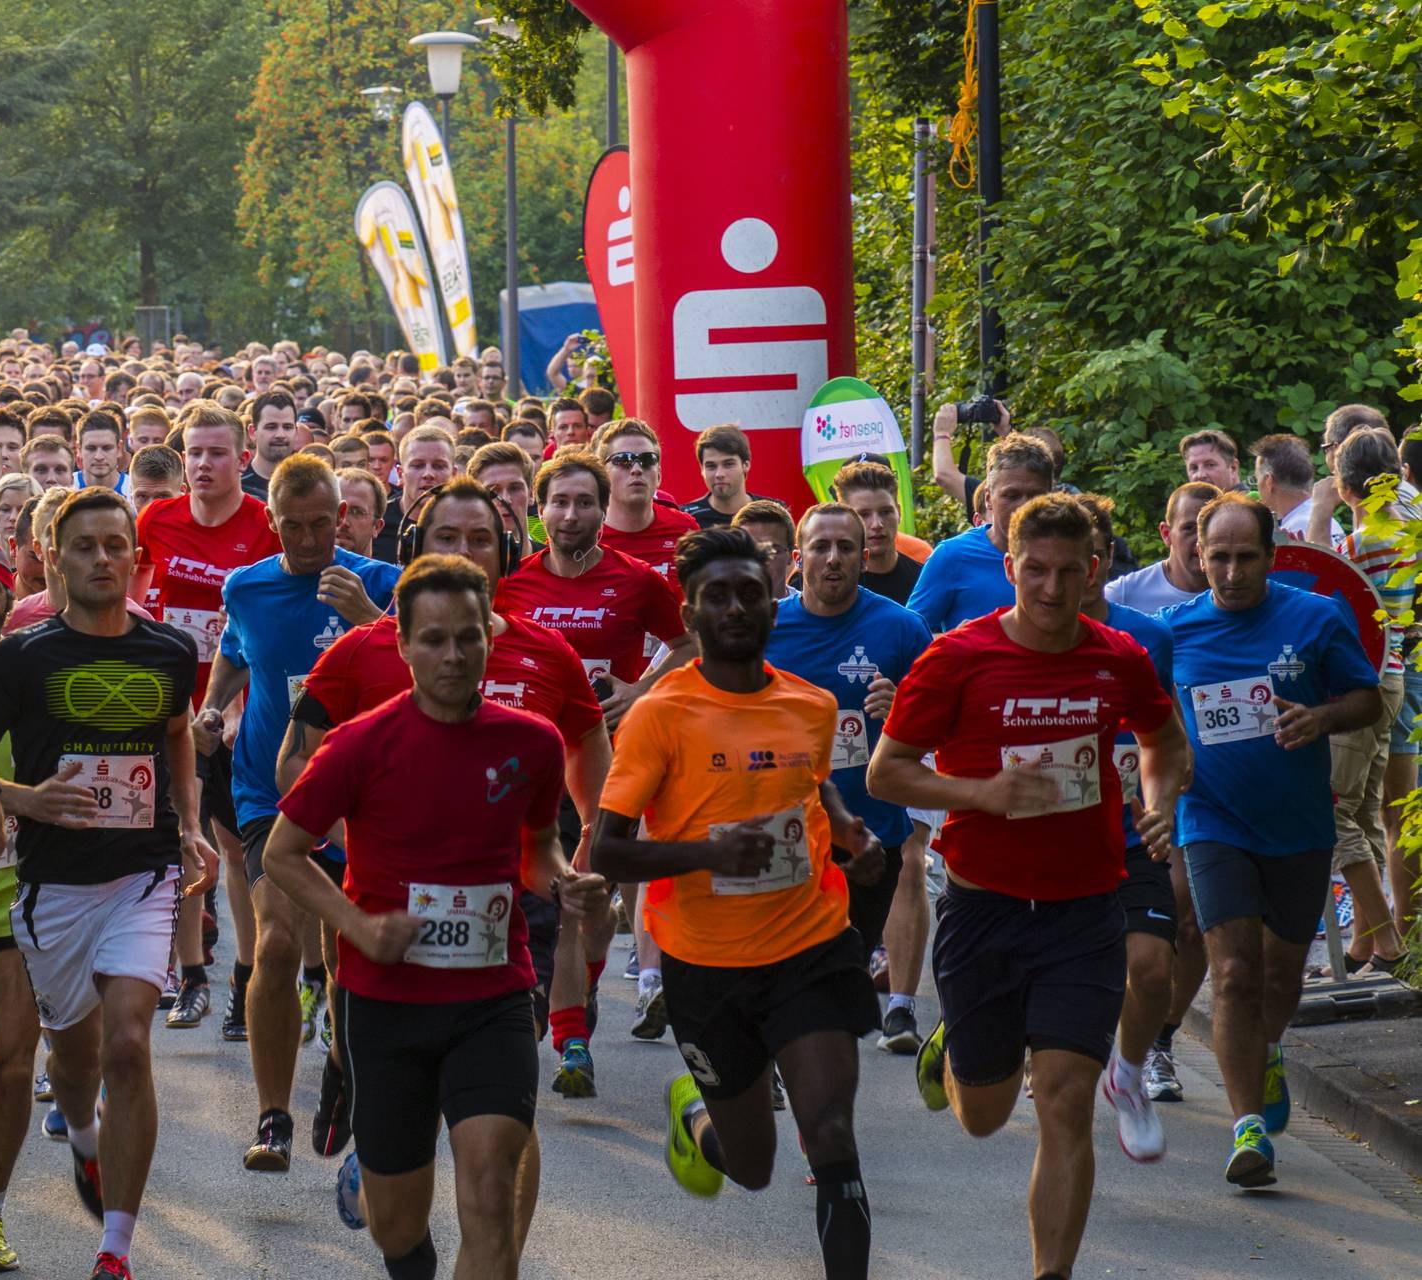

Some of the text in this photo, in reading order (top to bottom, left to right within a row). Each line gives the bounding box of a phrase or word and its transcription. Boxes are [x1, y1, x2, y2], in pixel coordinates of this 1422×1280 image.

[1003, 697, 1099, 716] ITH
[1003, 716, 1099, 727] Schraubtechnik
[1204, 706, 1241, 729] 363
[420, 919, 470, 947] 288
